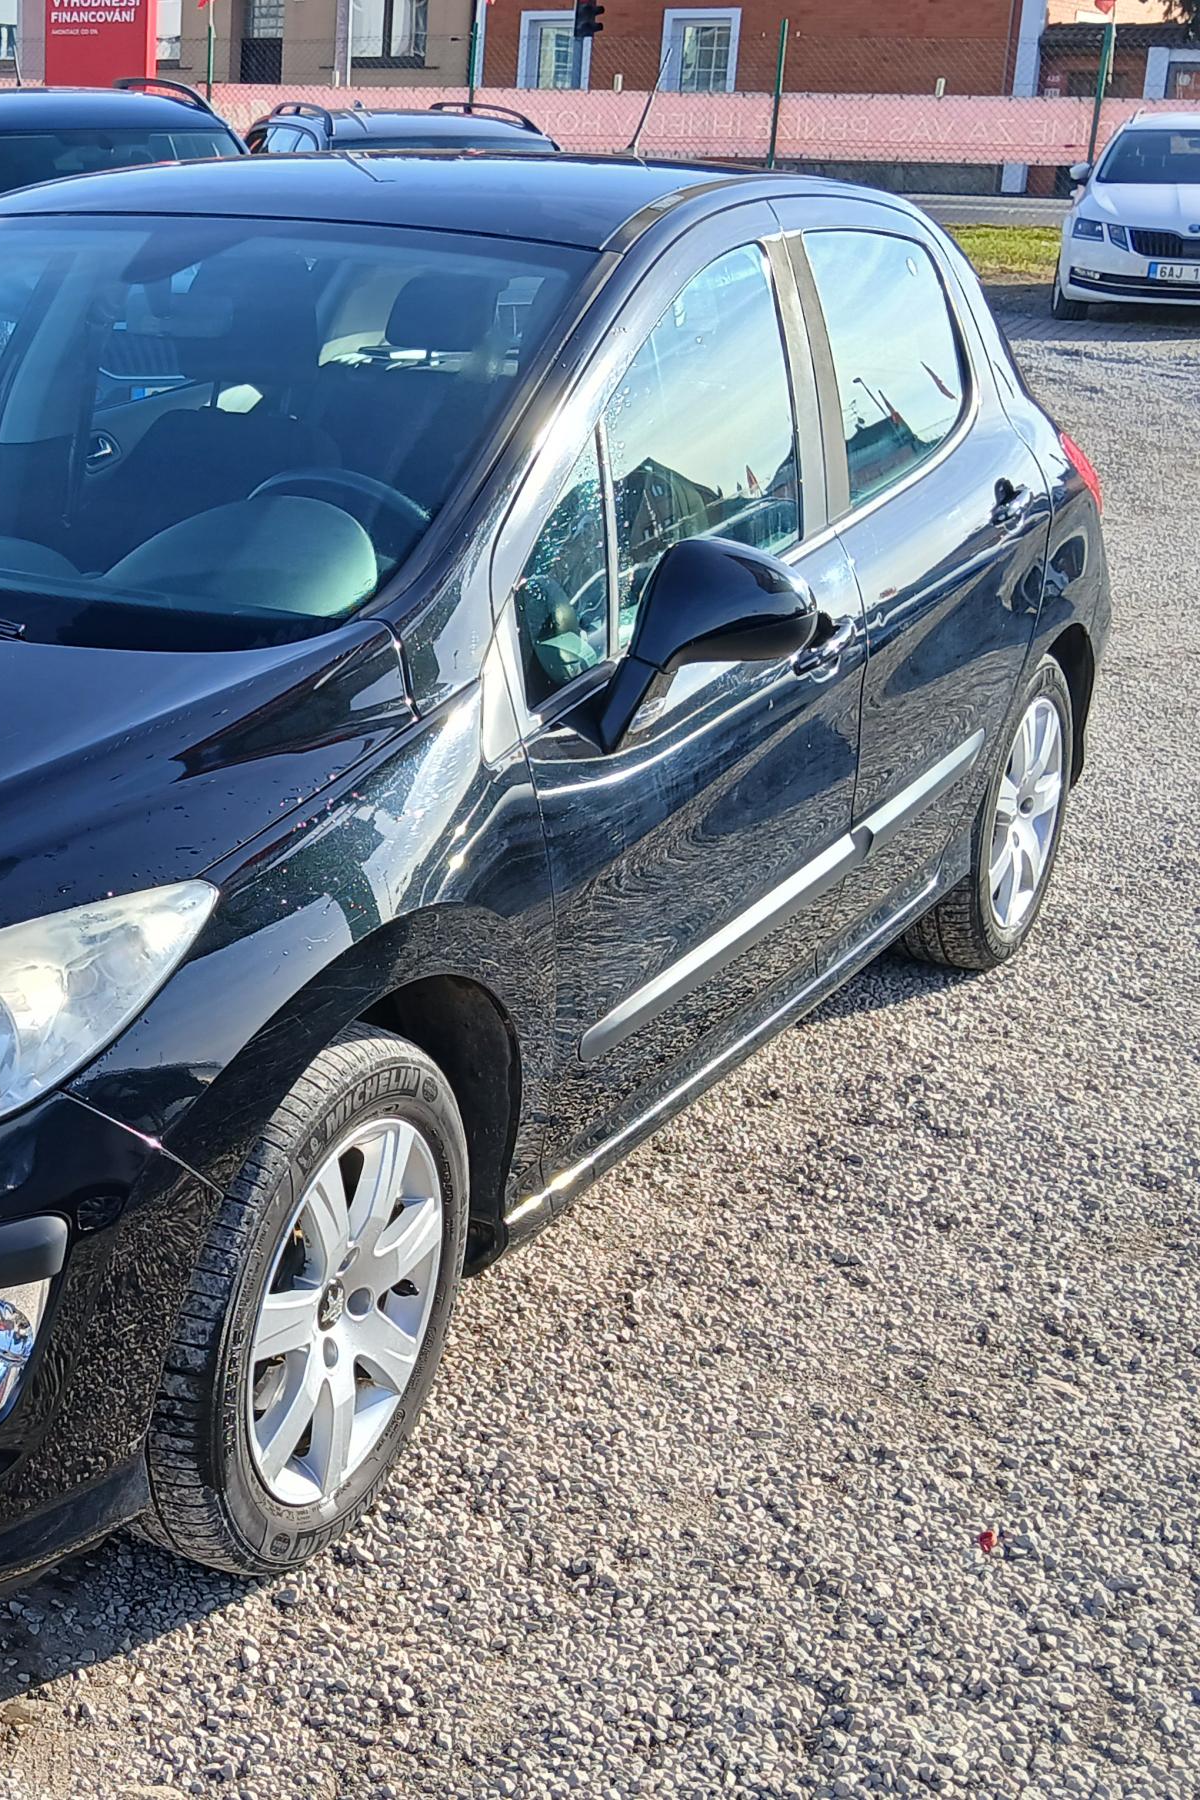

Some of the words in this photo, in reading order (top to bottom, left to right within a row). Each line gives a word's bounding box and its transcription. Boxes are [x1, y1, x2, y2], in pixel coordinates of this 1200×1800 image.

[50, 8, 136, 23] FINANCOVÁNÍ
[1160, 265, 1184, 280] 6AJ
[325, 1066, 421, 1140] MICHELIN
